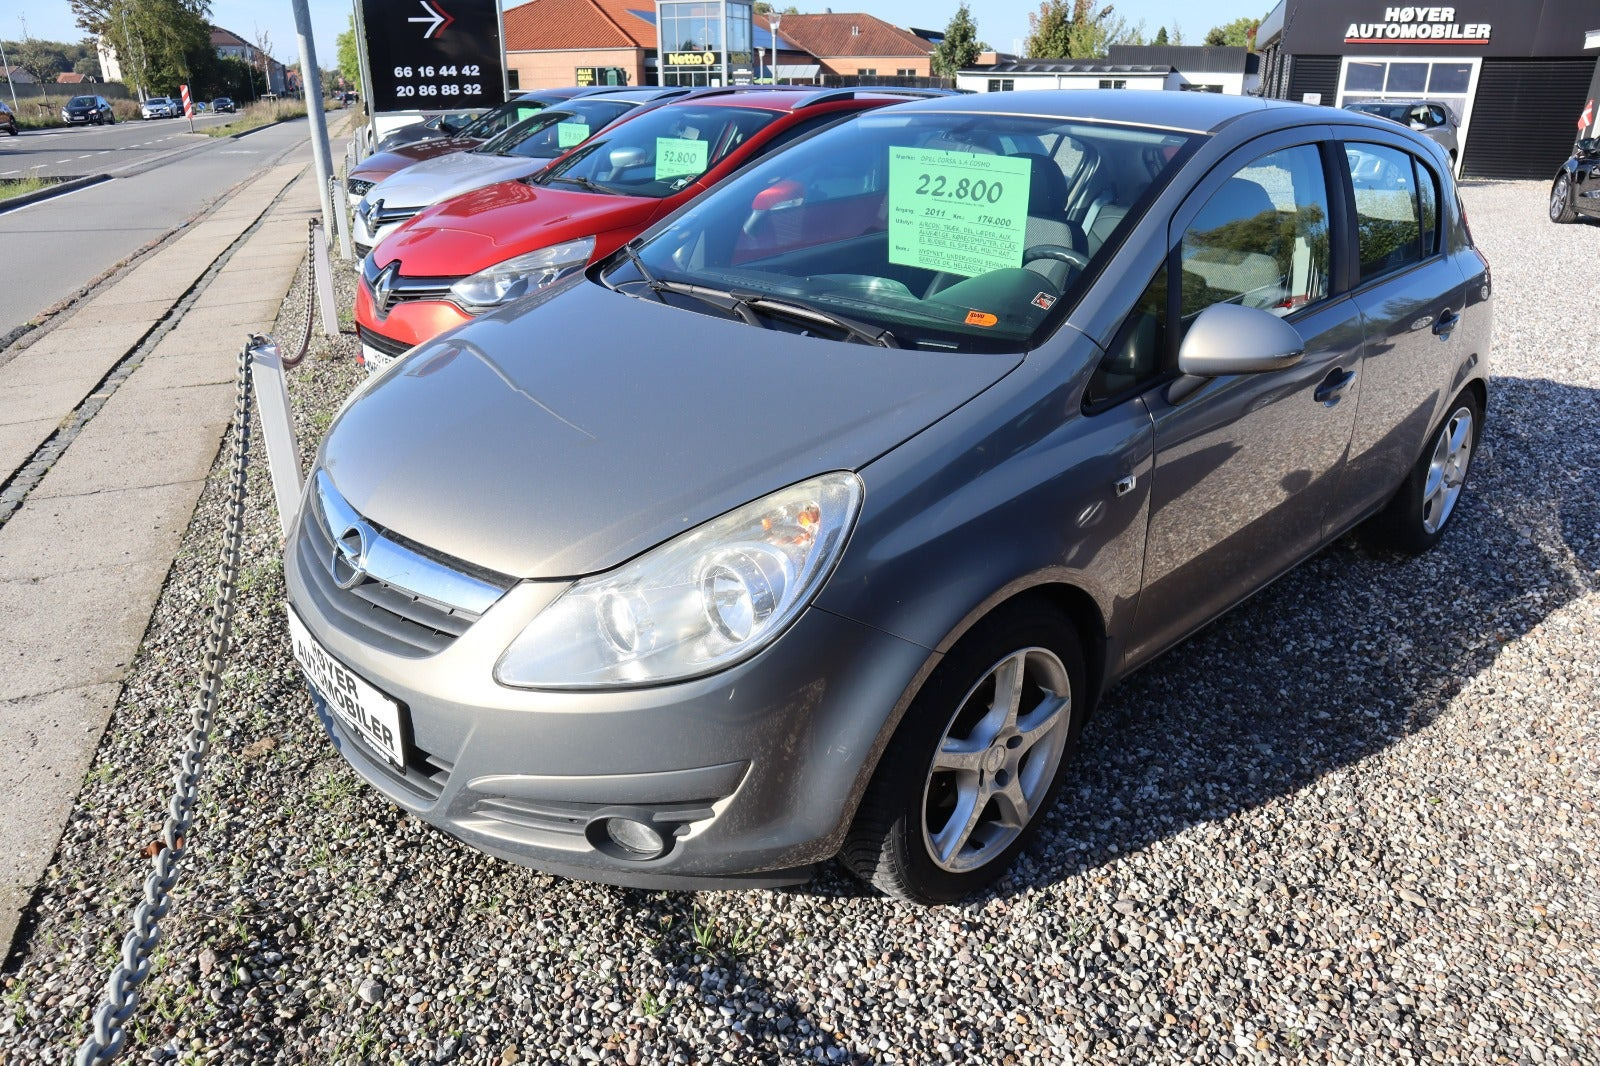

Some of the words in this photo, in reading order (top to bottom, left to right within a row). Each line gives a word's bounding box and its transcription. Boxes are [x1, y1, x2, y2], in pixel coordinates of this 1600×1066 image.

[1385, 6, 1456, 23] HØYER
[1345, 23, 1492, 39] AUTOMOBILER
[668, 53, 703, 65] Netto
[394, 66, 413, 78] 66
[418, 66, 435, 78] 16
[439, 65, 458, 77] 44
[461, 65, 480, 76] 42
[396, 86, 415, 97] 20
[418, 85, 437, 96] 86
[441, 84, 460, 96] 88
[463, 84, 482, 95] 32
[663, 150, 697, 164] 52.800
[920, 155, 936, 163] OPEL
[937, 156, 957, 165] CORSA
[969, 160, 991, 168] COSMO
[915, 173, 1003, 204] 22.800
[924, 207, 946, 217] 2011
[977, 215, 1012, 227] 174.000
[310, 638, 359, 700] HØYER
[298, 639, 395, 752] AUTOMOBILER
